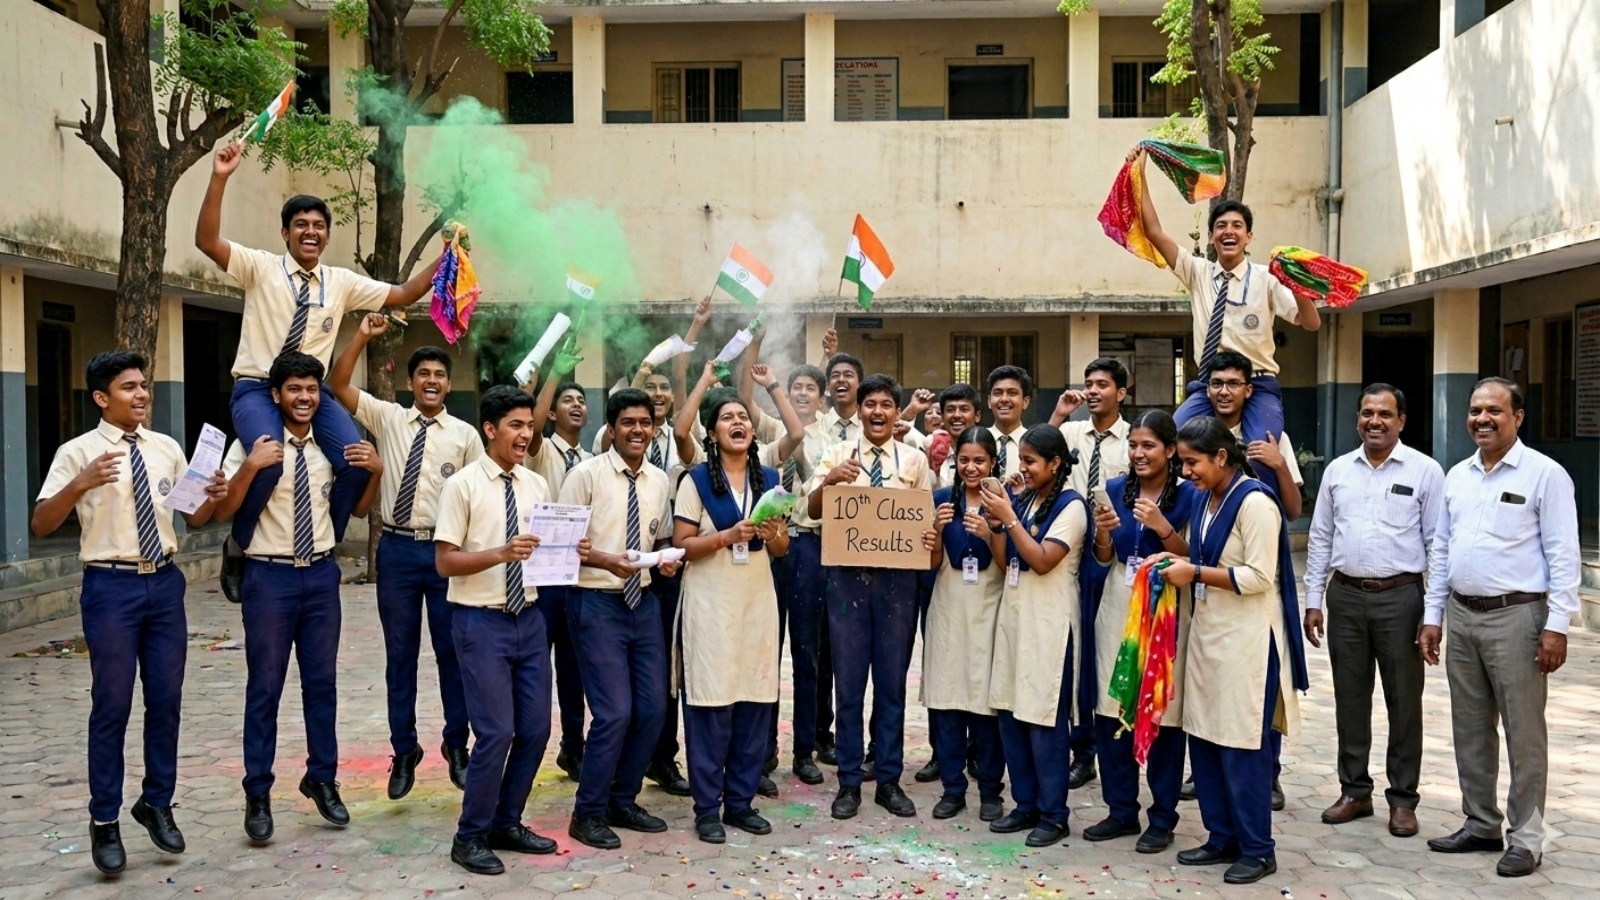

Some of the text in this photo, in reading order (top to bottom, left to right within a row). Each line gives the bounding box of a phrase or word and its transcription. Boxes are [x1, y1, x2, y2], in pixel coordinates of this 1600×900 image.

[833, 493, 924, 521] 10th Class
[845, 527, 914, 553] Results
